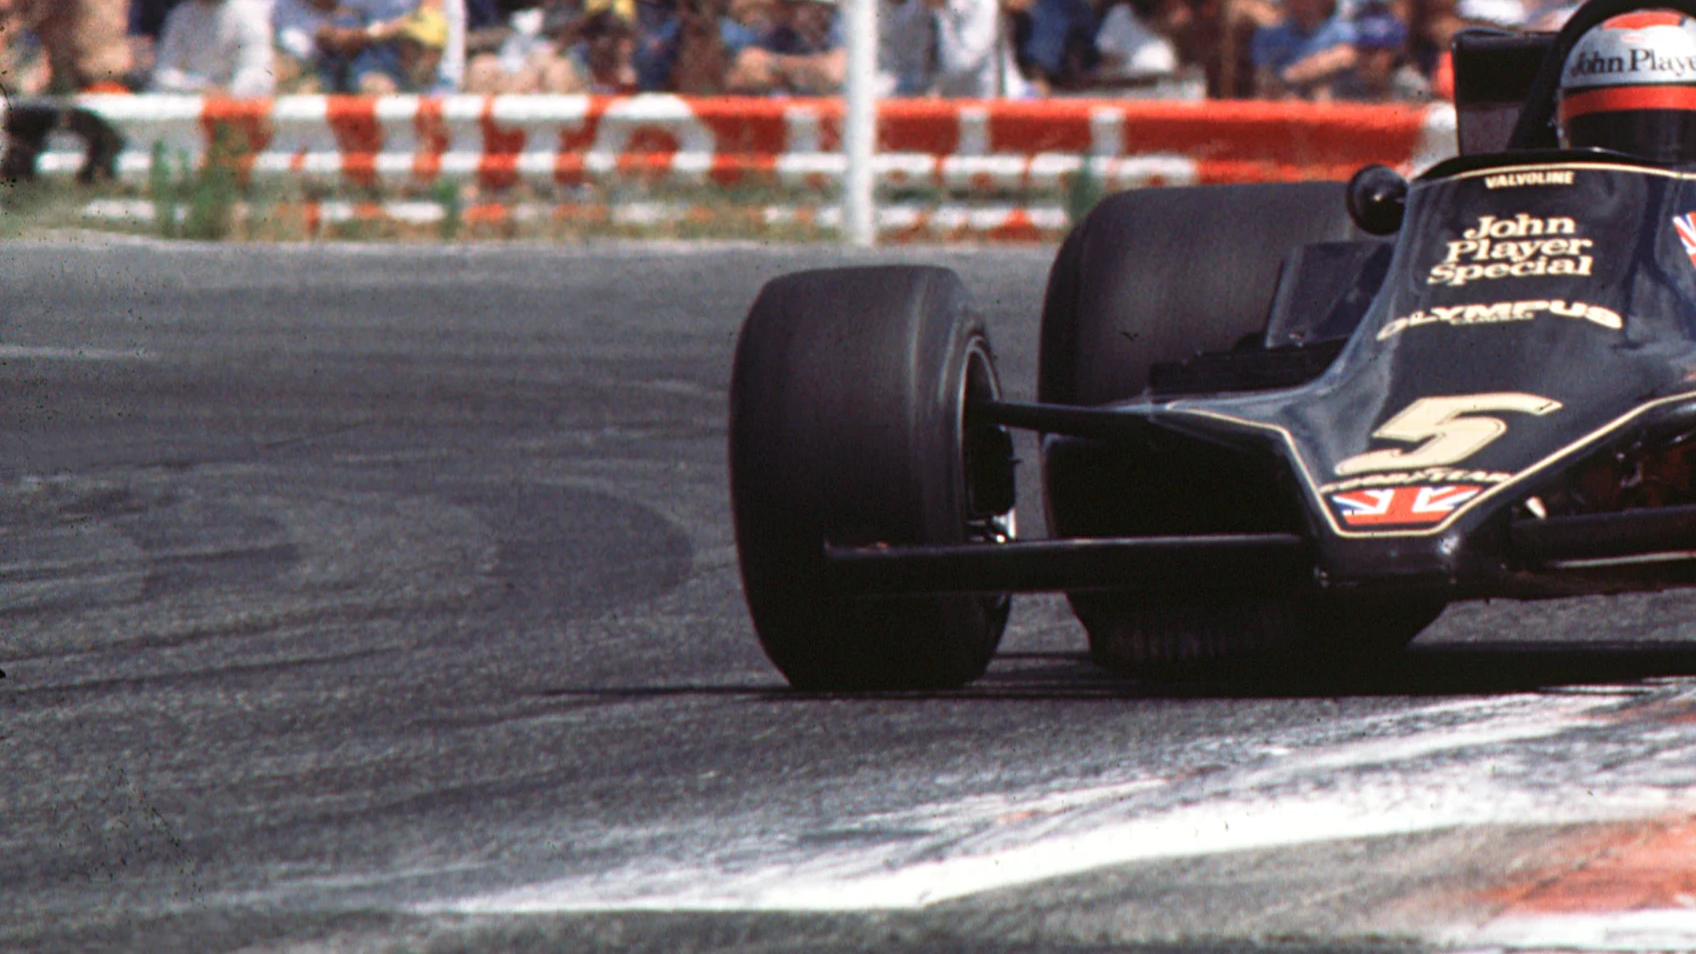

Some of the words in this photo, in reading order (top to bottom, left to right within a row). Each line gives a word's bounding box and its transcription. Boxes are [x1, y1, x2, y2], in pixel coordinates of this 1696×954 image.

[1571, 49, 1626, 79] John
[1484, 171, 1575, 189] VALVOLINE
[1463, 212, 1577, 240] John
[1441, 237, 1594, 264] Player
[1426, 254, 1594, 287] Special
[1375, 298, 1624, 342] OLYMPUS
[1334, 391, 1565, 476] 5
